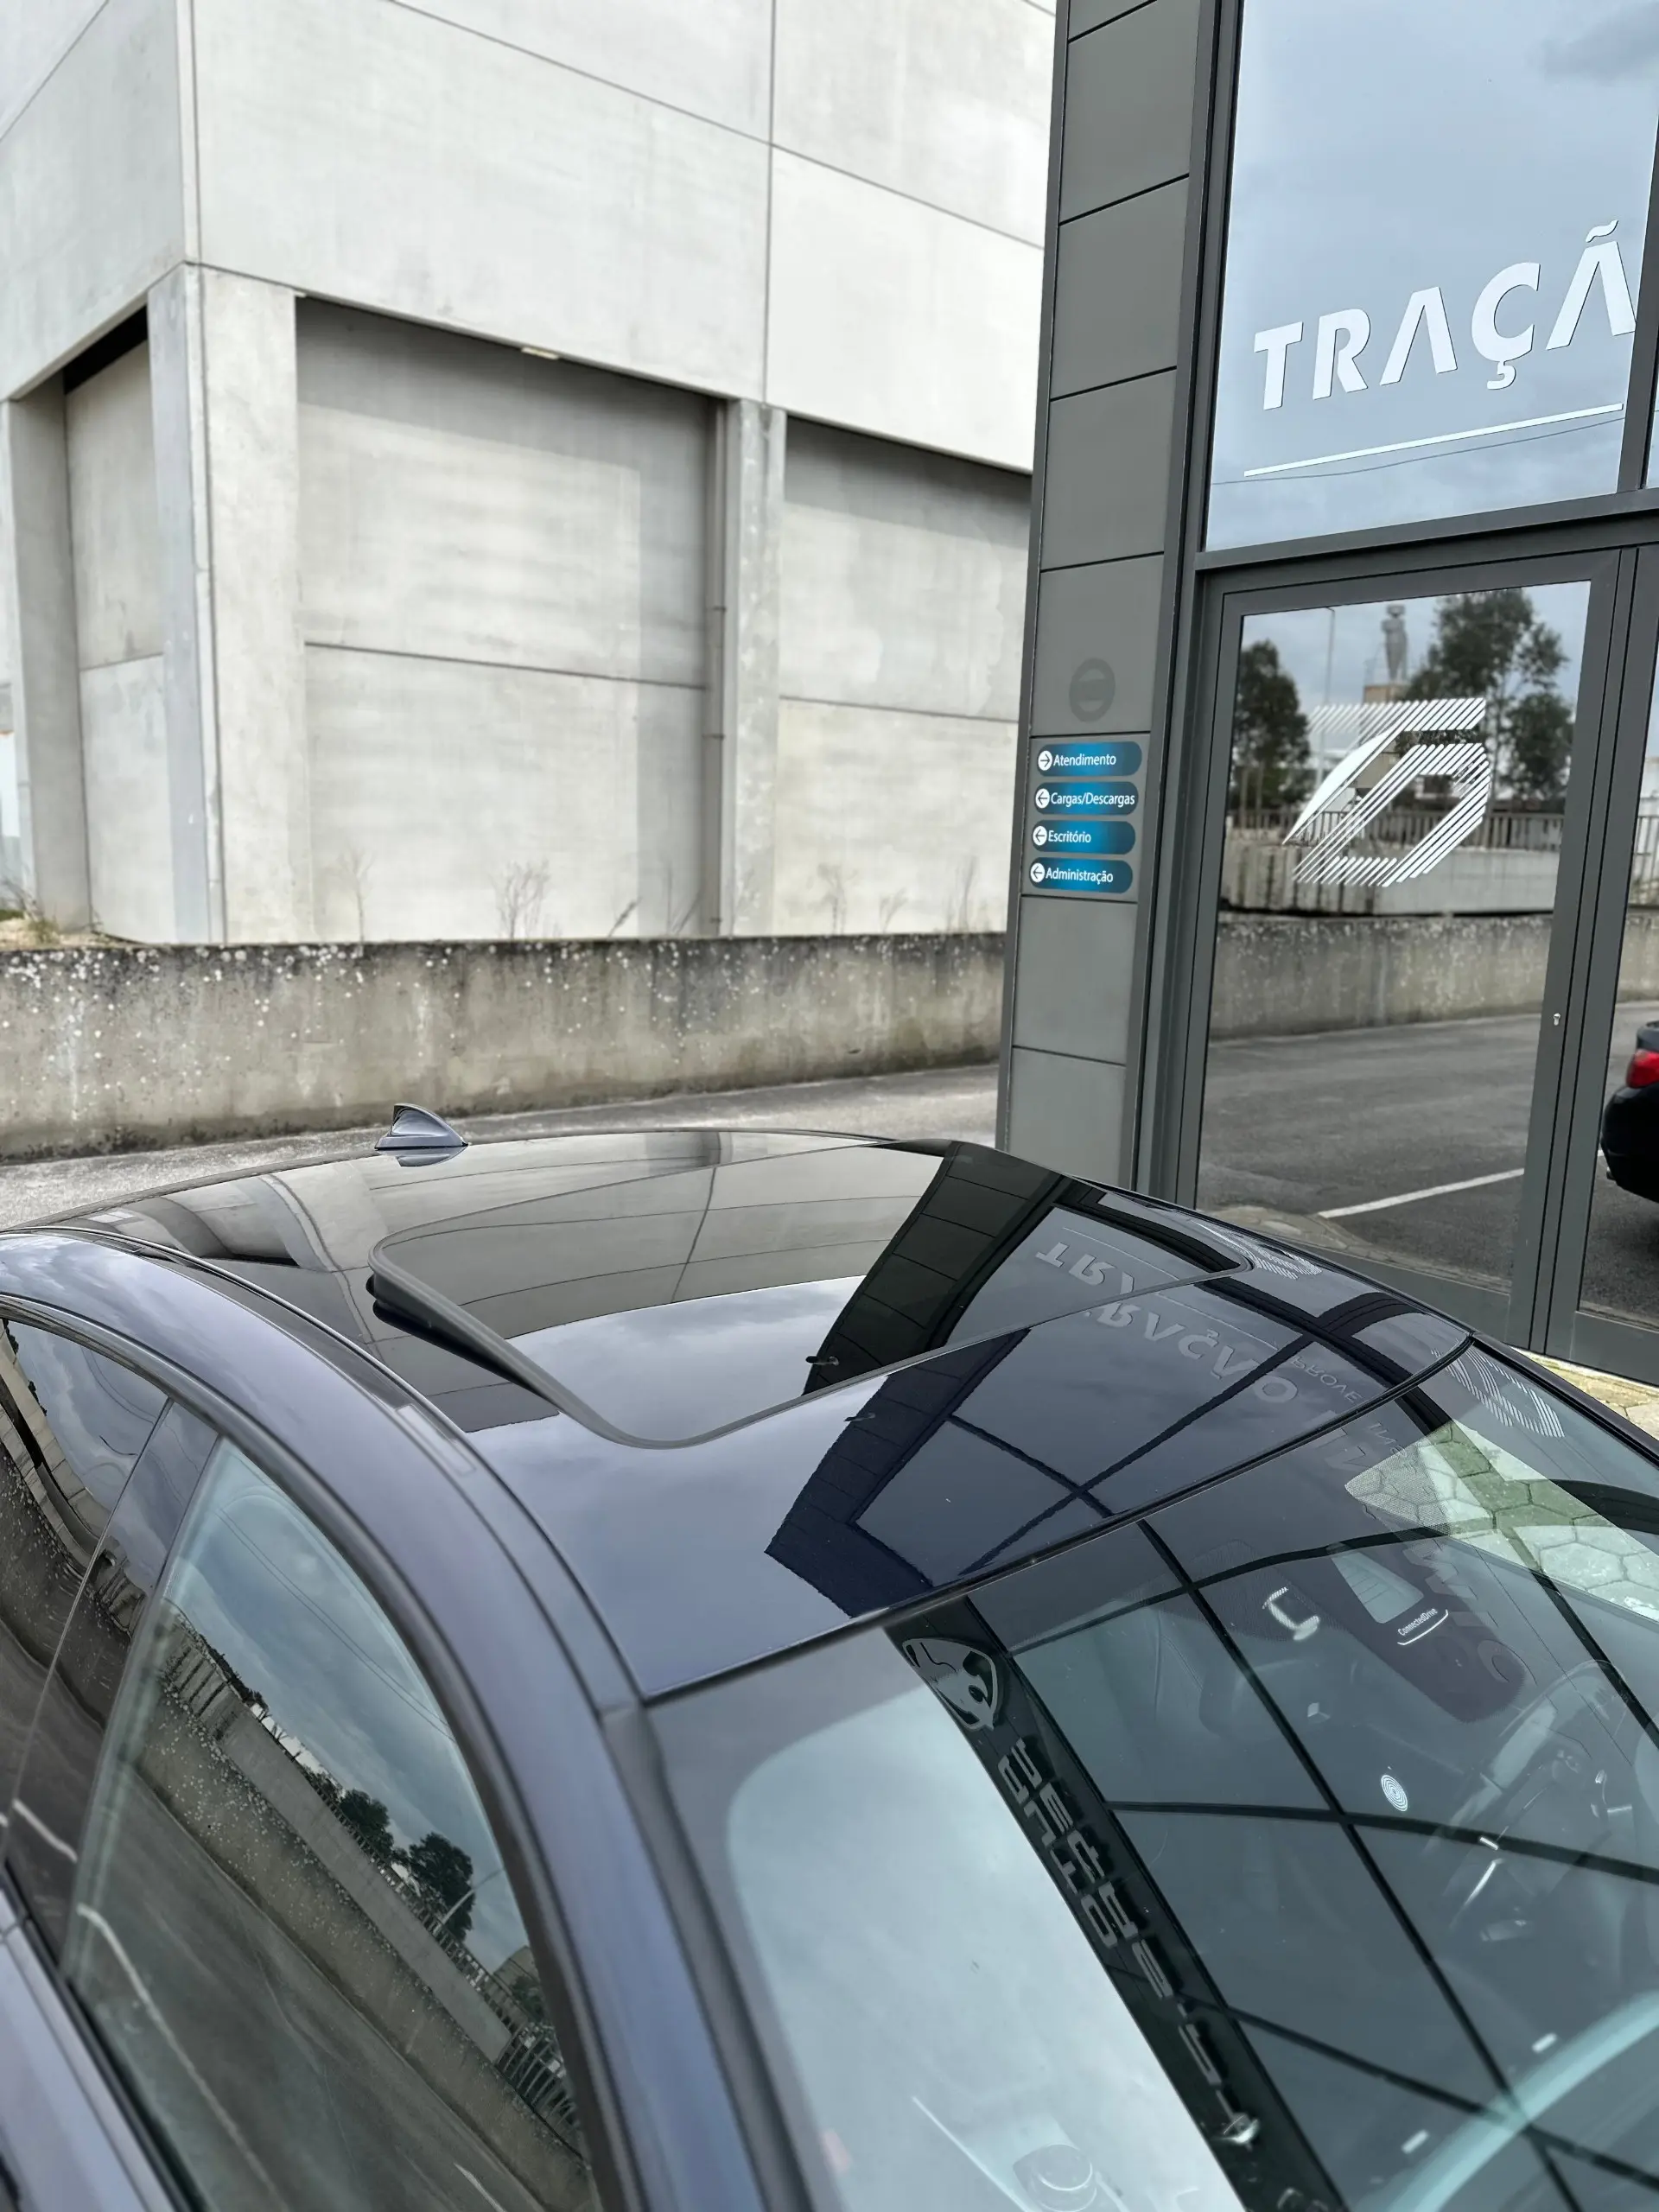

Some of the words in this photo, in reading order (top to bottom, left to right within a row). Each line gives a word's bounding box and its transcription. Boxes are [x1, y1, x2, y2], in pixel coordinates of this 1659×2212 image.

[1253, 219, 1637, 411] TRAÇÃ
[1053, 753, 1116, 767] Atendimento
[1051, 791, 1135, 808] Cargas/Descargas
[1048, 830, 1091, 843] Escritório
[1046, 868, 1114, 885] Administração
[1397, 1608, 1439, 1636] ConnectedDrive
